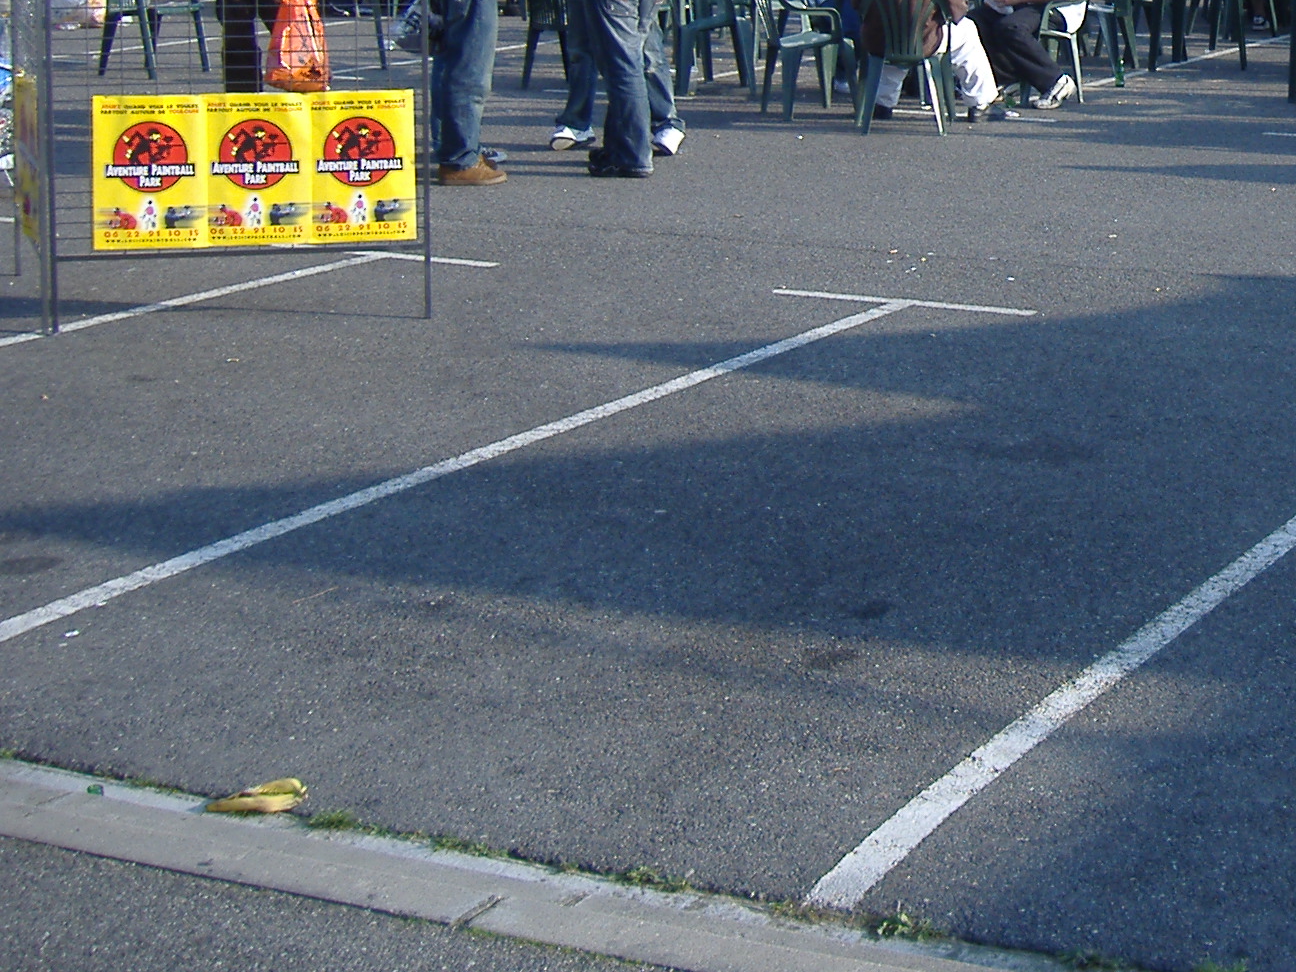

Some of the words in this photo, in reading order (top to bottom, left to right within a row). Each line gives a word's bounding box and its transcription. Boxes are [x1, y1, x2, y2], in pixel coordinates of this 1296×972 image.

[106, 165, 149, 177] AVENTURE
[151, 163, 195, 176] PAINTBALL
[212, 162, 254, 174] AVENTURE
[256, 161, 299, 173] PAINTBALL
[317, 160, 359, 172] AVENTURE
[361, 159, 402, 170] PAINTBALL
[139, 176, 162, 187] PARK
[244, 173, 267, 184] PARK
[349, 170, 371, 182] PARK
[210, 227, 224, 235] 06
